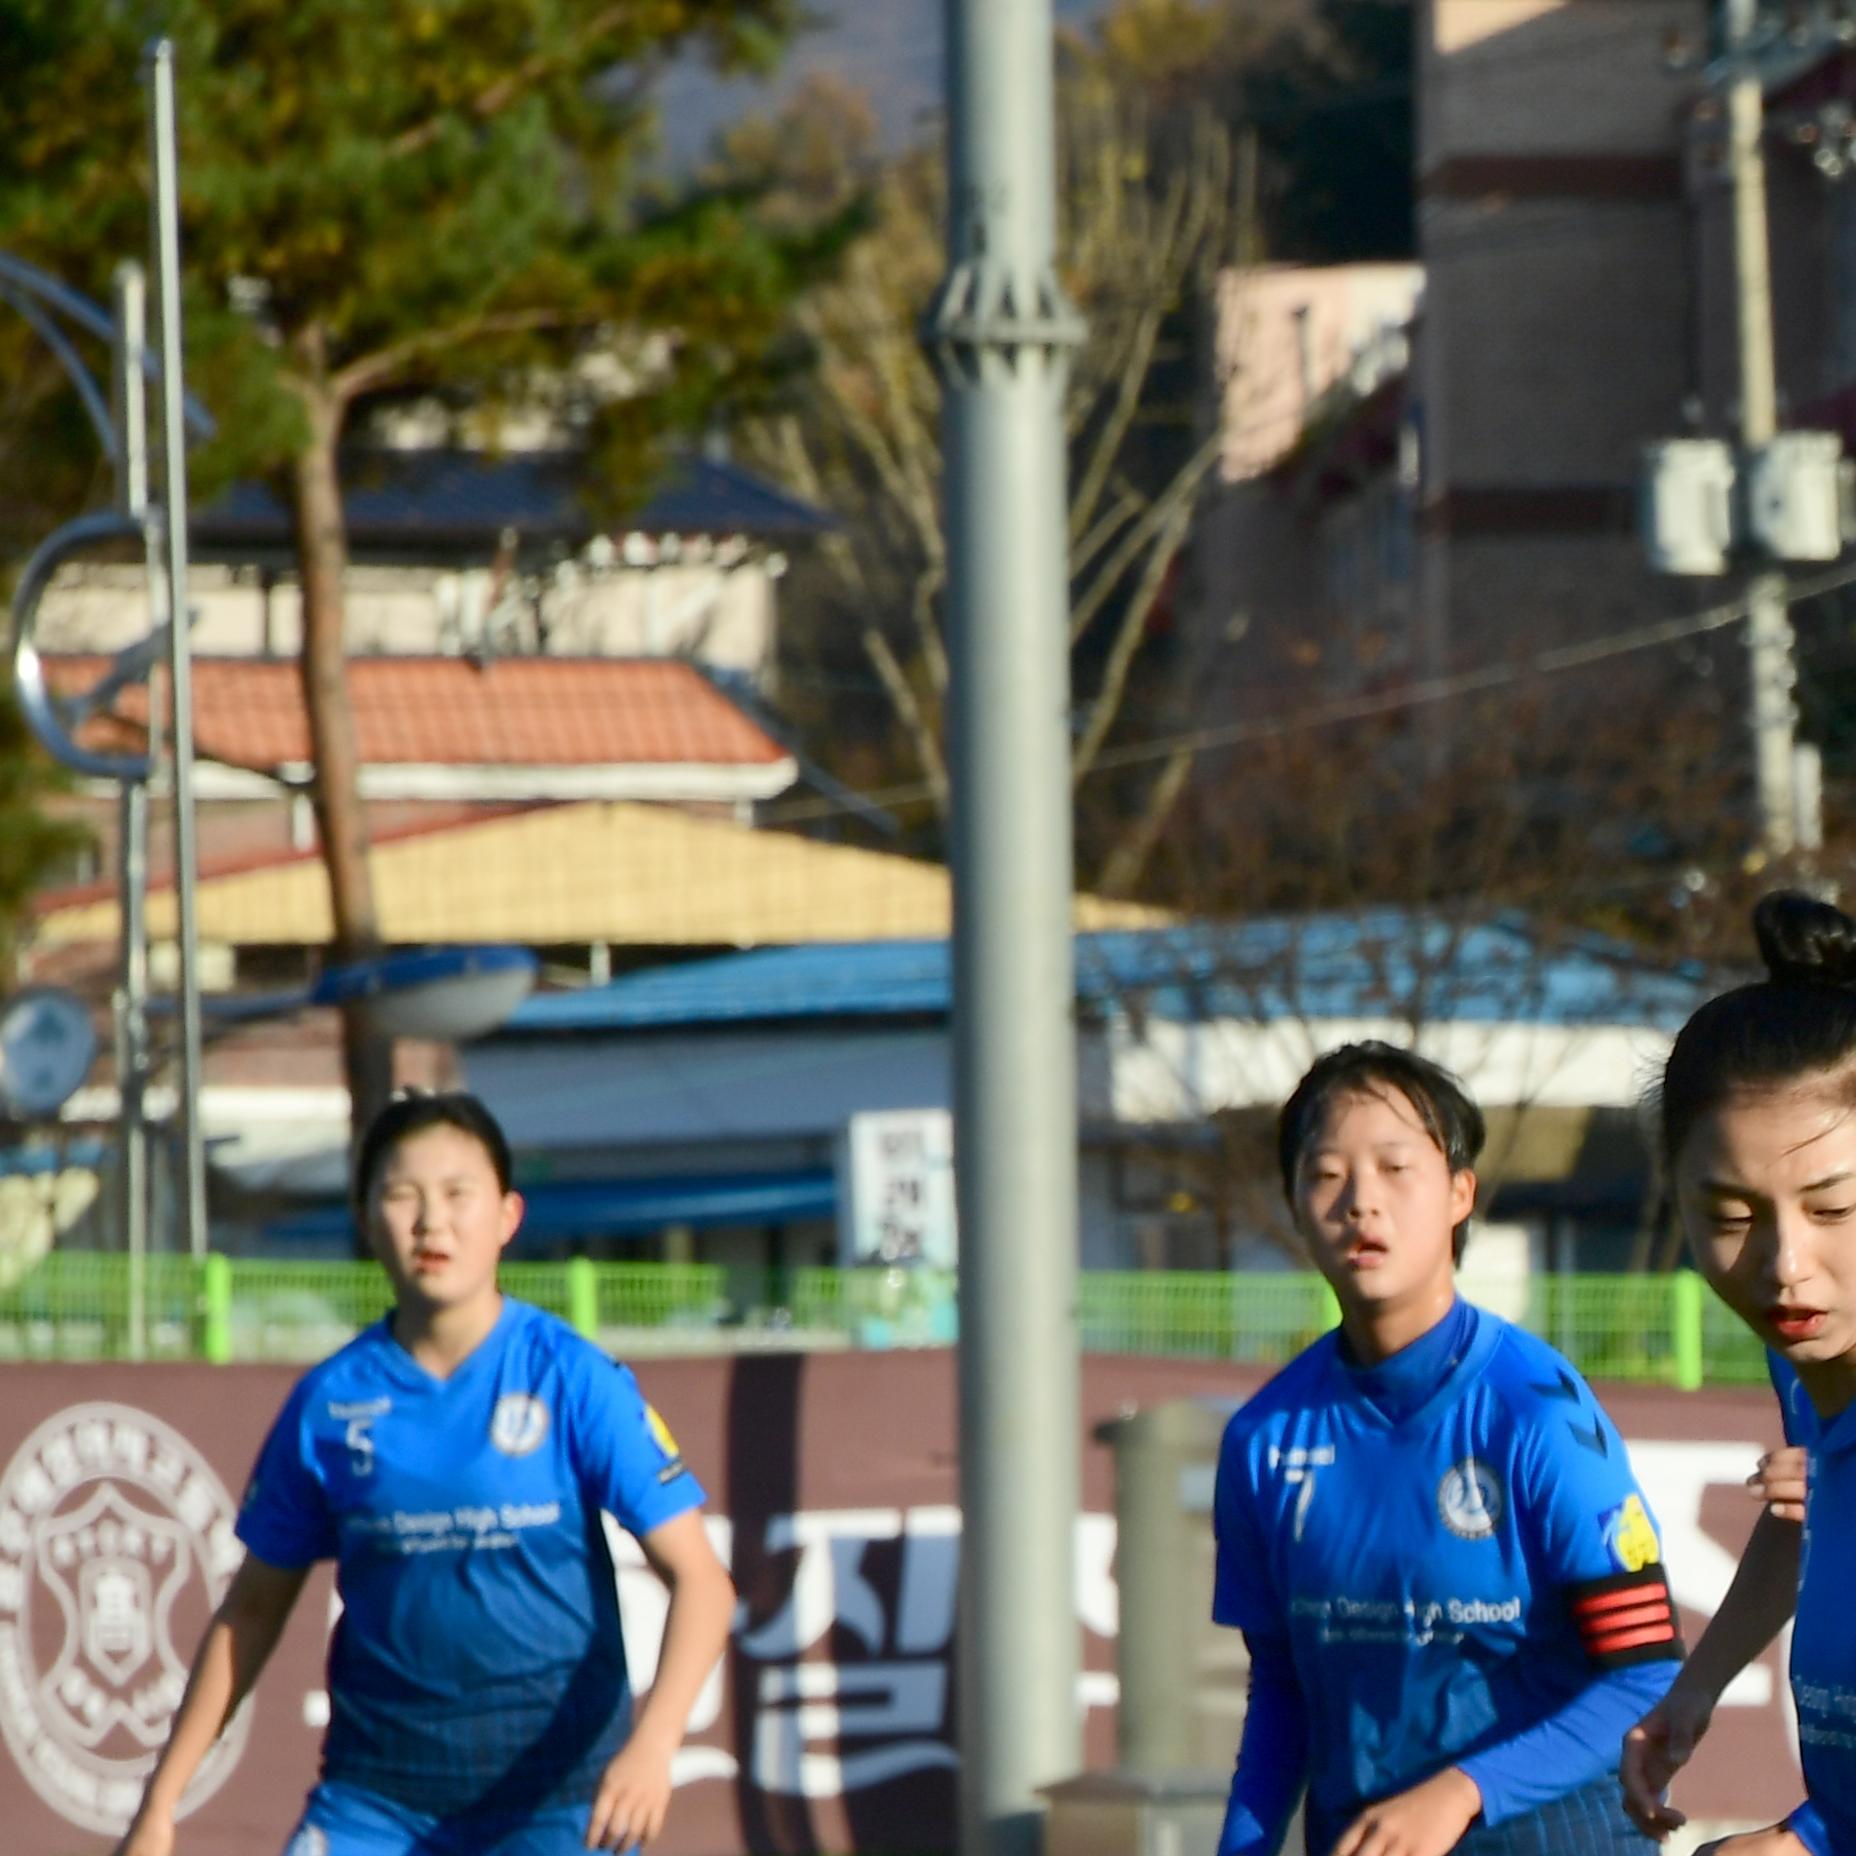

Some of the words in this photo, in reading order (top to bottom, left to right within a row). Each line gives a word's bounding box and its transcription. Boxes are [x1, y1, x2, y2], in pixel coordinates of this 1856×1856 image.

[346, 1414, 375, 1477] 5
[1284, 1467, 1316, 1542] 7
[1448, 1595, 1521, 1624] School
